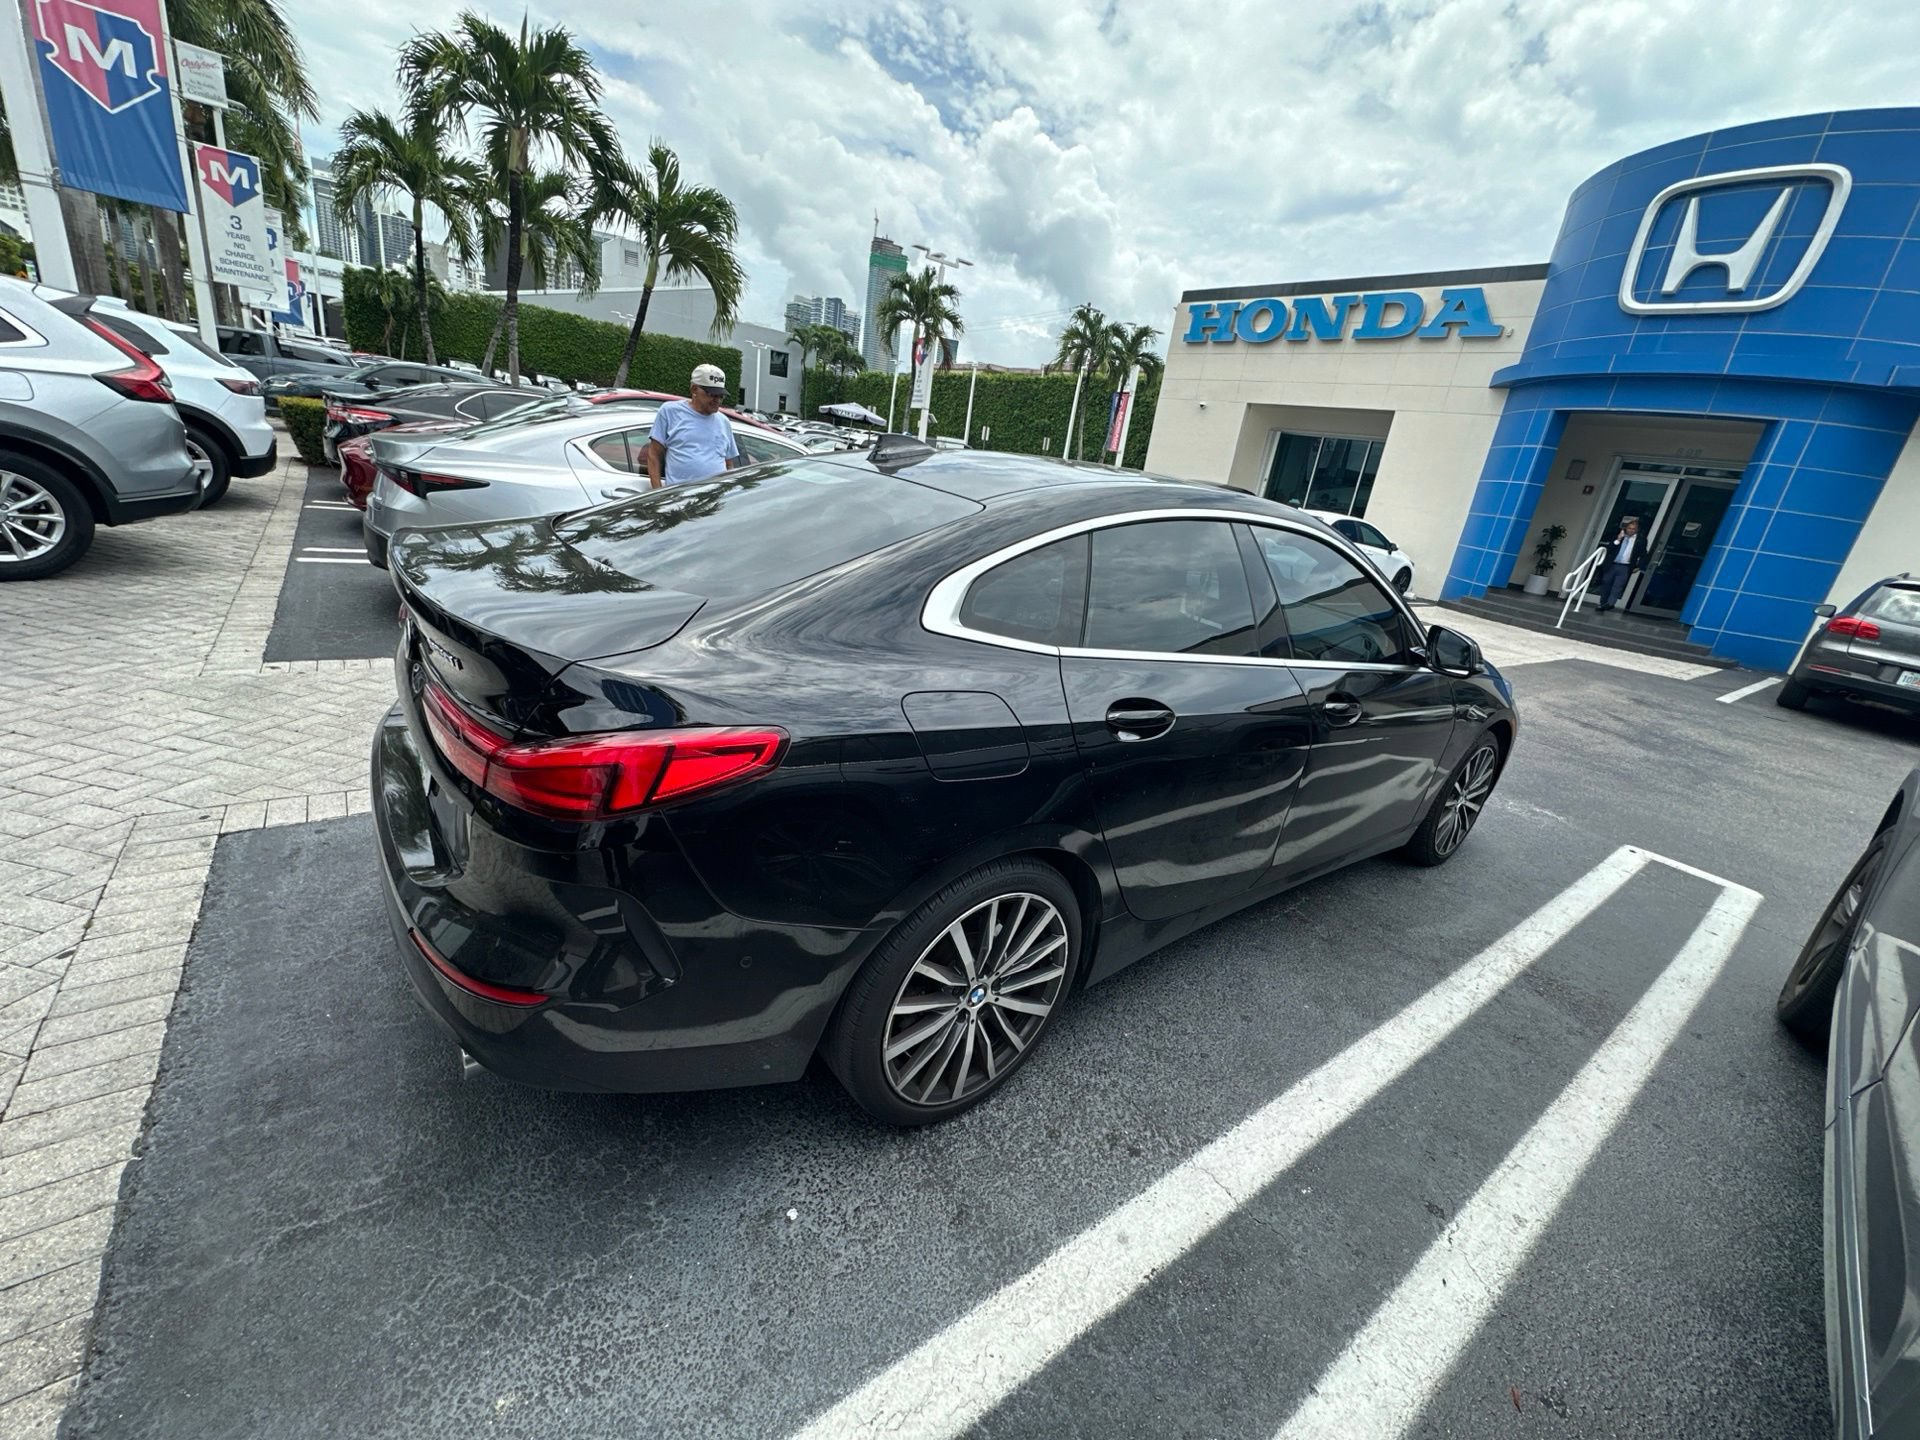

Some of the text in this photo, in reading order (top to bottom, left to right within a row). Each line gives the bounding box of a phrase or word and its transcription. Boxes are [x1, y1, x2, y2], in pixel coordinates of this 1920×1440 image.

[63, 22, 138, 79] M
[209, 160, 250, 190] M
[229, 214, 243, 231] 3
[225, 230, 251, 242] YEARS
[233, 241, 246, 250] NO
[224, 249, 256, 261] CHARGE
[219, 257, 265, 272] SCHEDULED
[215, 265, 271, 282] MAINTENANCE
[1183, 287, 1503, 343] HONDA
